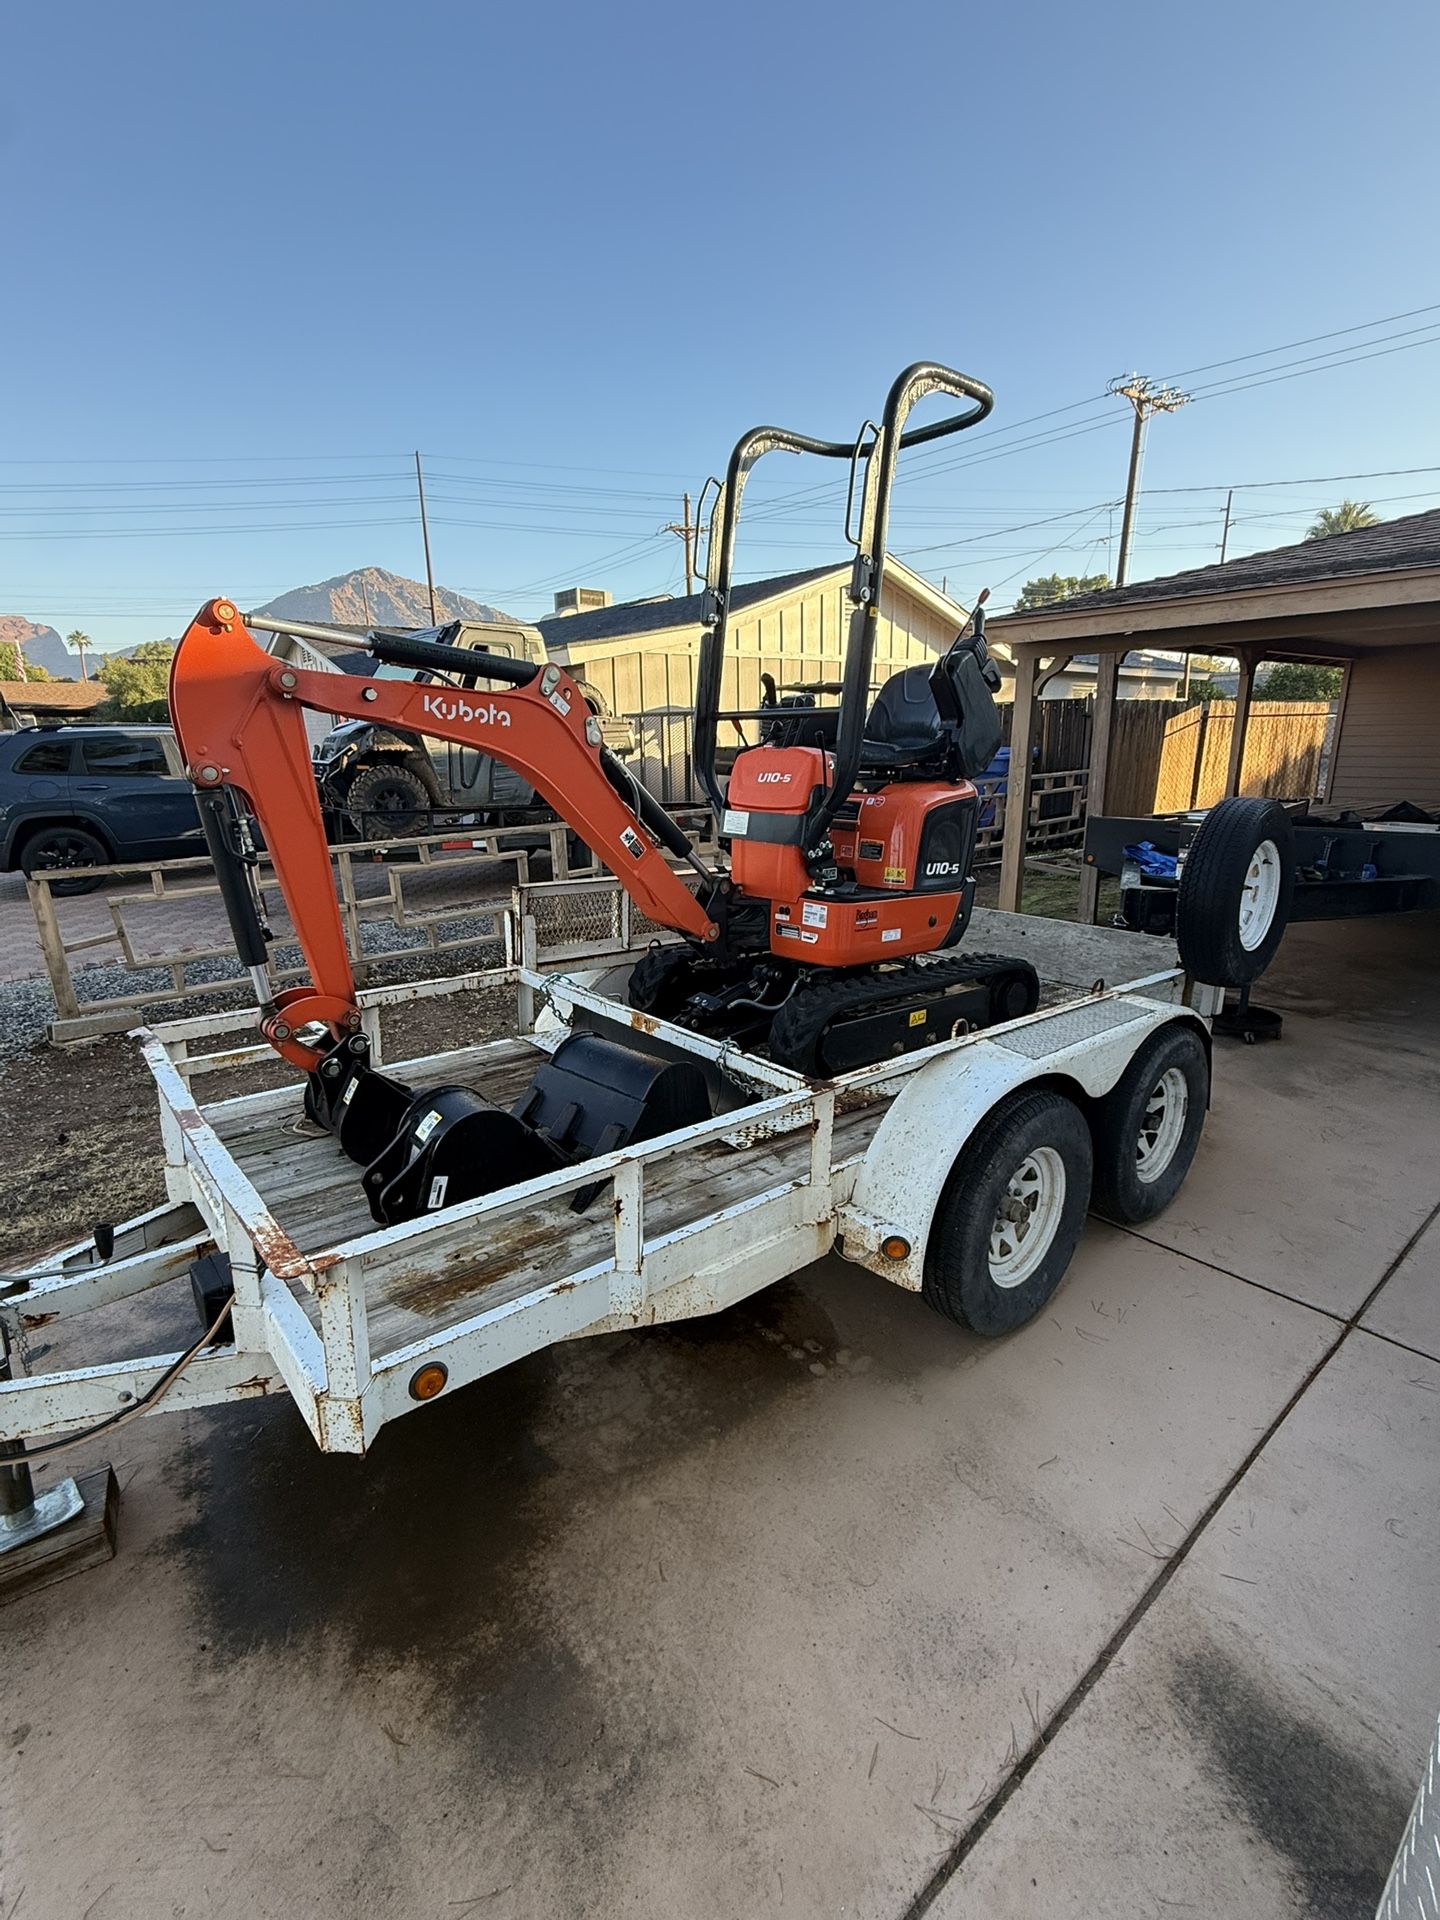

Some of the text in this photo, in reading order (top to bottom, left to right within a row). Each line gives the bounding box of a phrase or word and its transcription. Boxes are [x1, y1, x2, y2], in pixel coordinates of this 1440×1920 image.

[424, 694, 511, 727] Kubota
[757, 772, 792, 783] U10-5
[926, 862, 960, 876] U10-5
